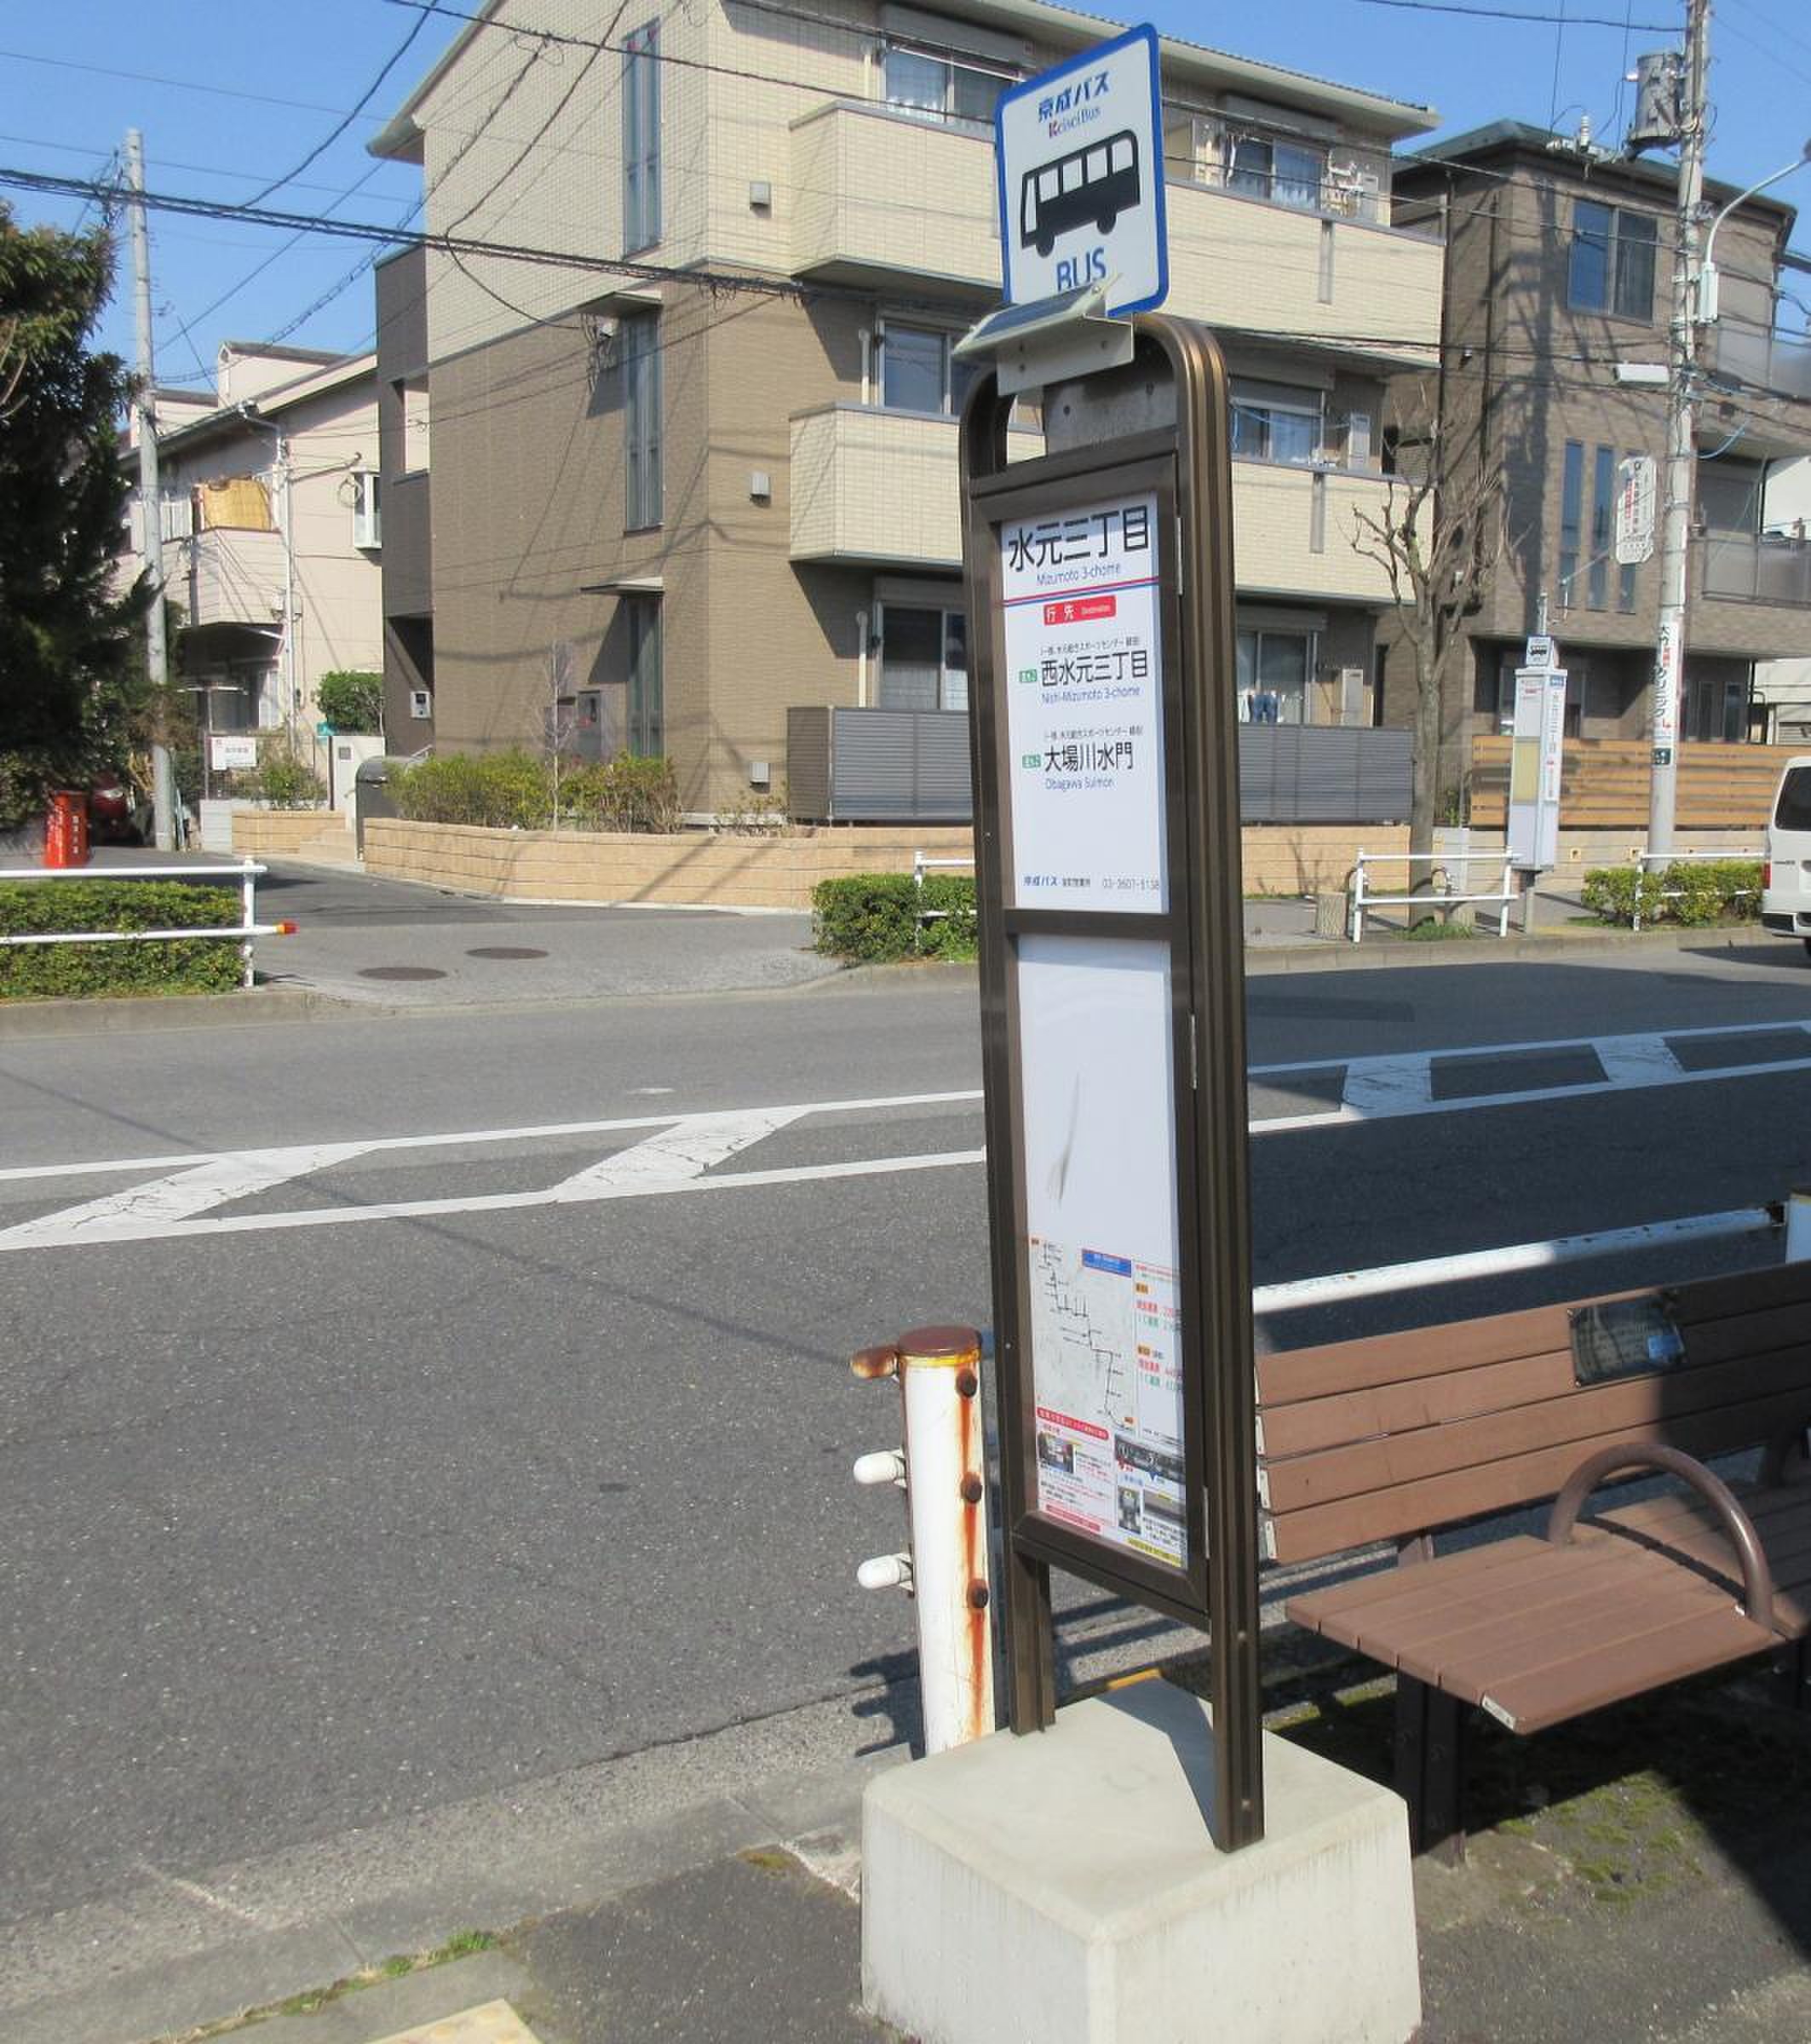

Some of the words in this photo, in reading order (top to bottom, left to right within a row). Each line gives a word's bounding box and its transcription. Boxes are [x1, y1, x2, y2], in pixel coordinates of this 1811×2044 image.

[1038, 72, 1110, 123] 京成バス
[1056, 246, 1107, 291] BUS
[1008, 504, 1149, 572] 水元三丁目
[1036, 569, 1079, 586] Mizumoto
[1041, 650, 1148, 687] 西水元三丁目
[1044, 741, 1134, 773] 大場川水門
